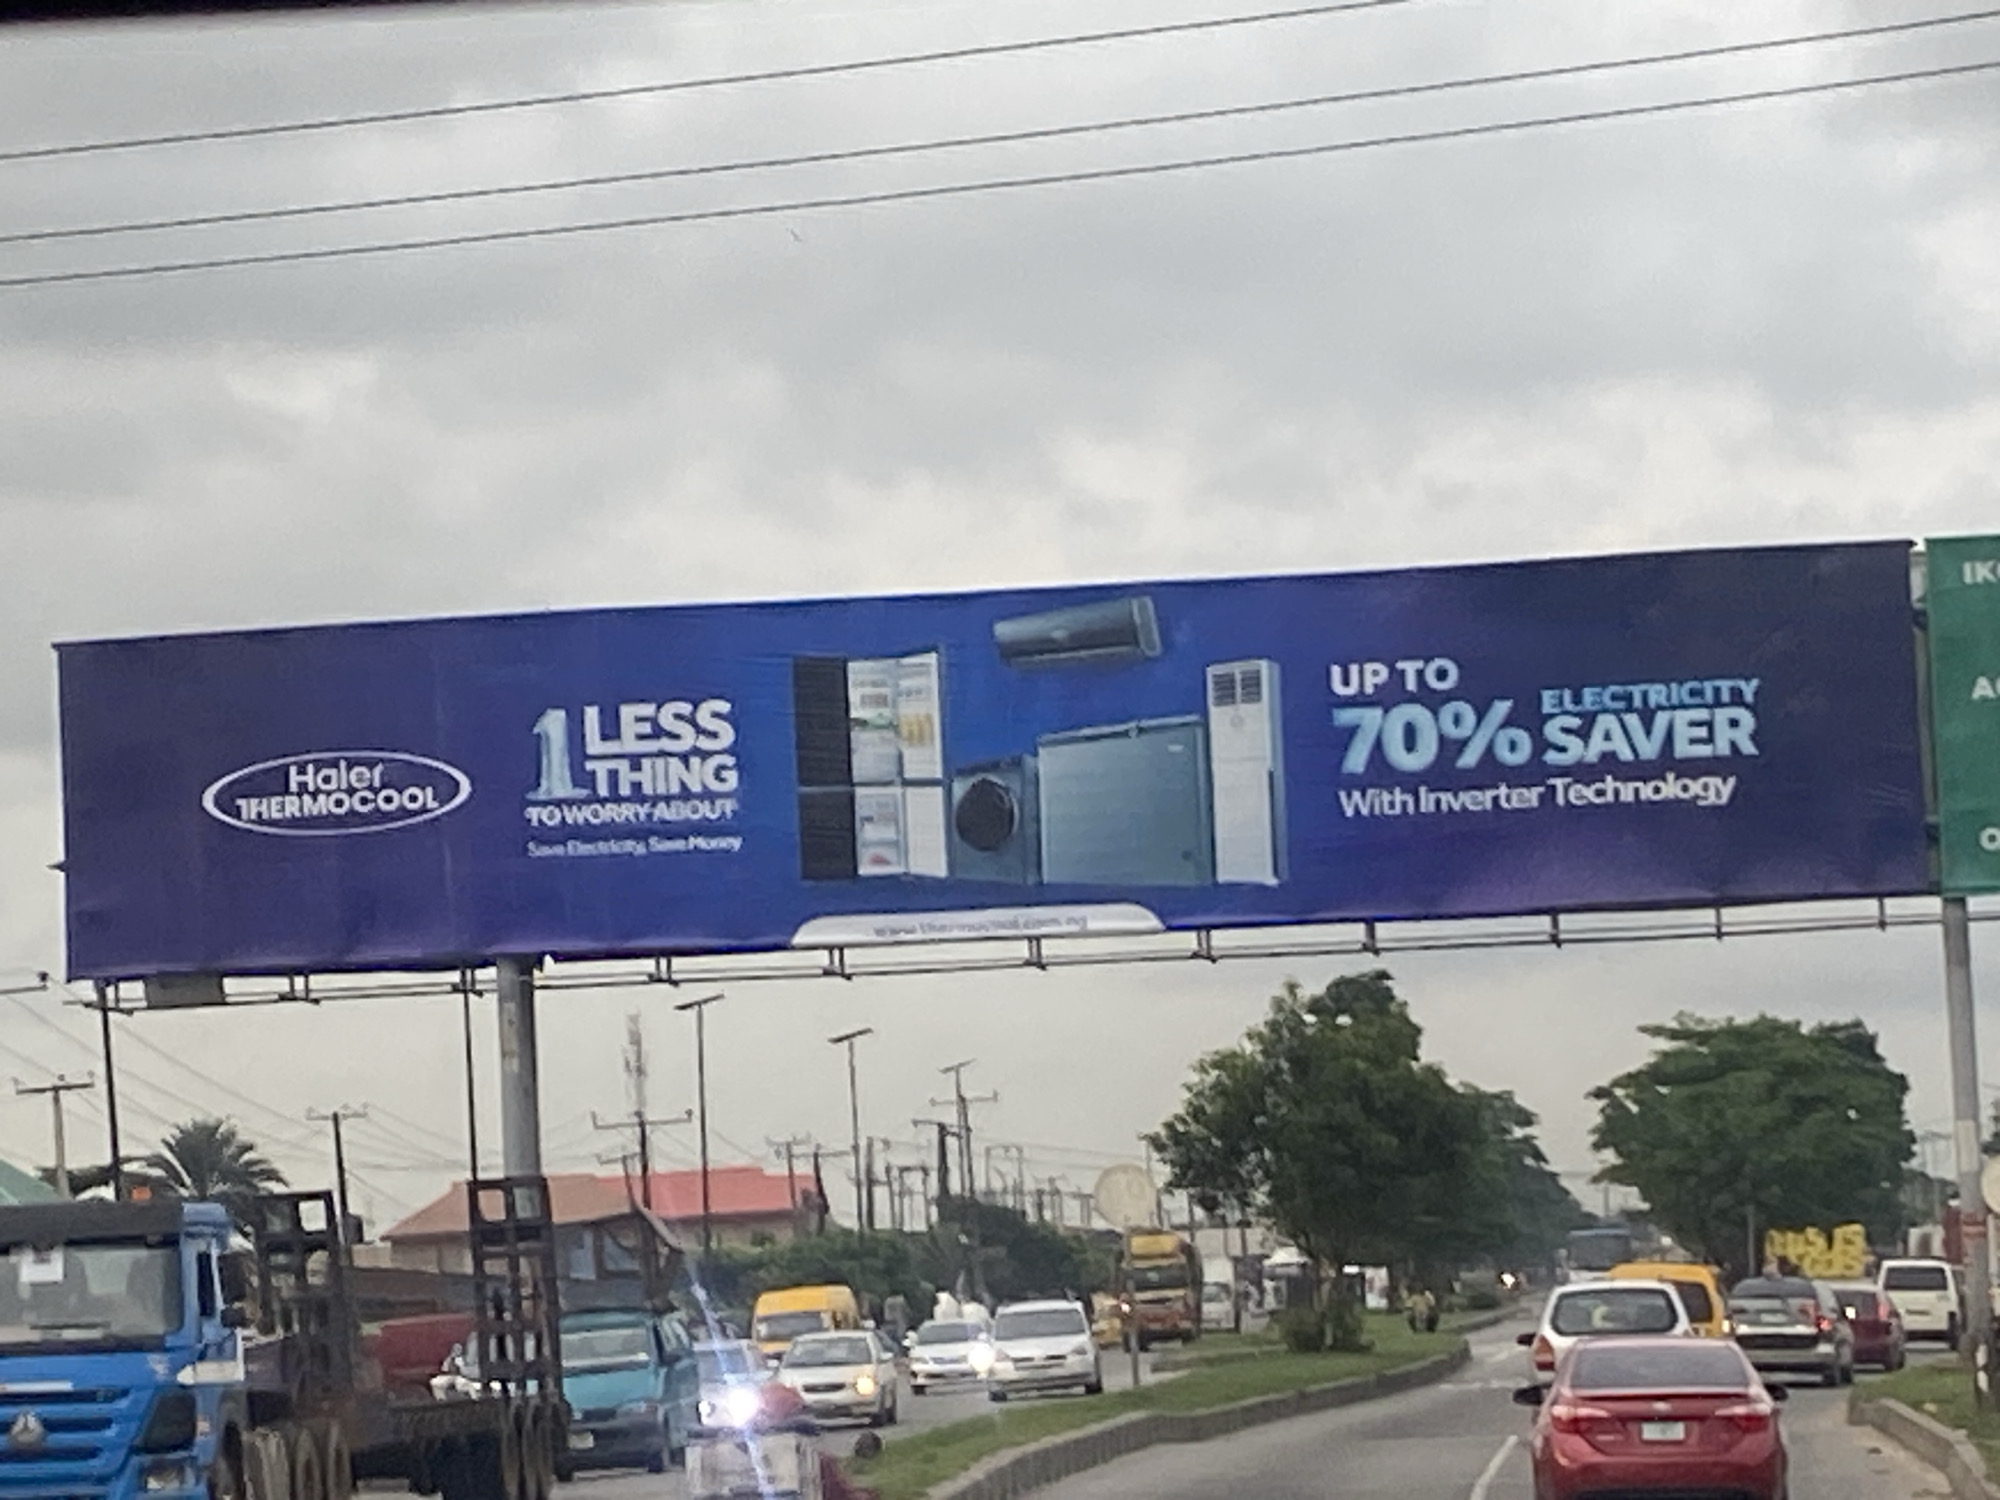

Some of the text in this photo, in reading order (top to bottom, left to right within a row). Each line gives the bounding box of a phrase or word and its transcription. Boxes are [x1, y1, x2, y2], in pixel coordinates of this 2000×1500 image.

[1963, 560, 2000, 584] IK
[1330, 658, 1459, 695] UP TO
[1972, 676, 2000, 699] A
[1540, 678, 1759, 714] ELECTRICITY
[526, 699, 736, 799] 1 LESS
[1333, 699, 1759, 774] 70% SAVER
[585, 754, 739, 797] THING
[236, 787, 439, 821] THERMOCOOL
[525, 798, 738, 826] TO WORRY ABOUT
[1338, 771, 1736, 818] With Inverter Technology
